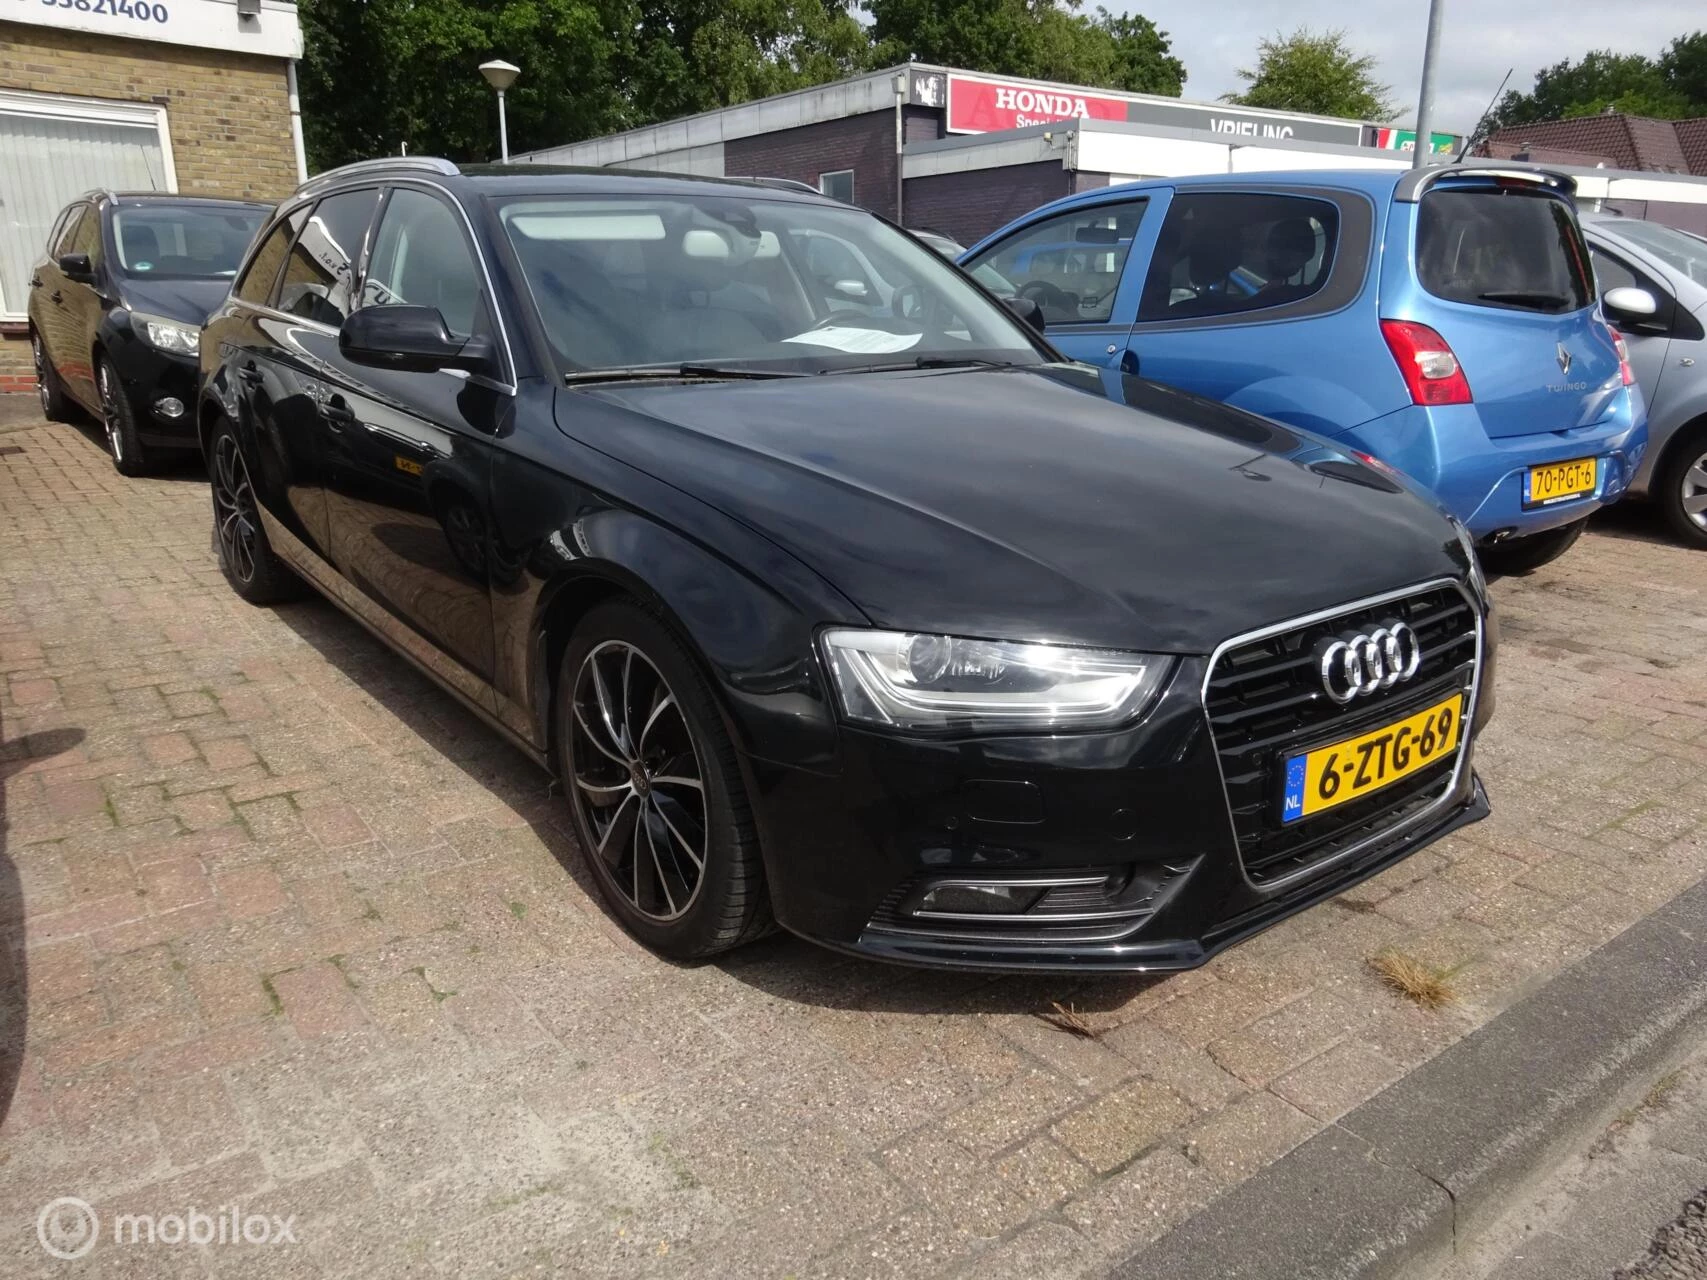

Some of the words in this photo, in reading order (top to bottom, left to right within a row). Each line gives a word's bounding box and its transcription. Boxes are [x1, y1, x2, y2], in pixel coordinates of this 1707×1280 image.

[995, 87, 1090, 118] HONDA
[1546, 381, 1588, 393] TWINGO
[1536, 463, 1592, 496] 70-PGT-6
[1318, 707, 1453, 800] 6-ZTG-69
[1285, 795, 1301, 811] NL
